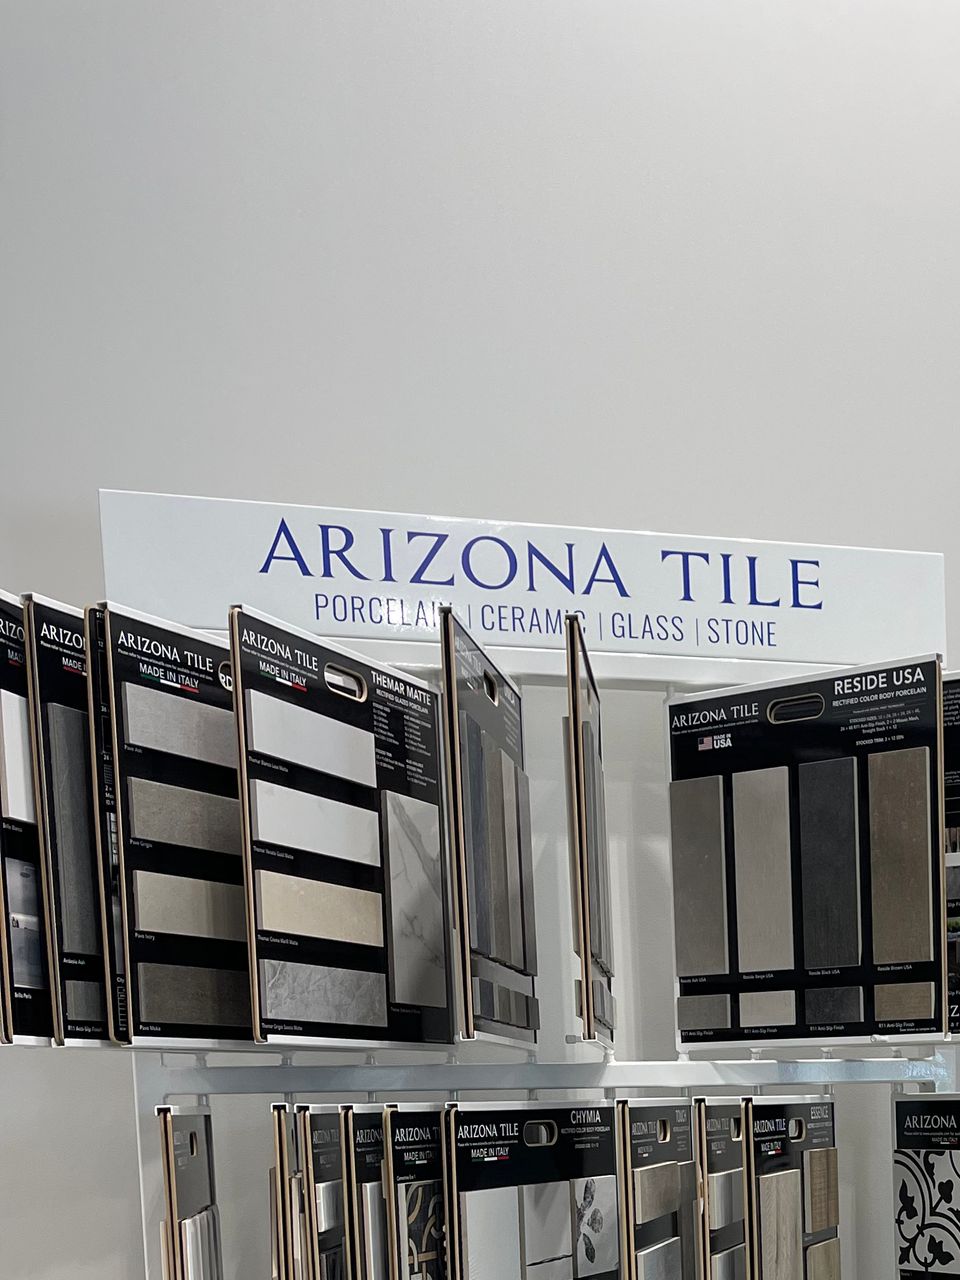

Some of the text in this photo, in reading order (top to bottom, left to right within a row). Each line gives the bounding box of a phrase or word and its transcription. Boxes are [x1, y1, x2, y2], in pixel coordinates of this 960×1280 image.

[259, 517, 825, 610] ARIZONA TILE
[315, 593, 452, 629] PORCELAI
[611, 611, 685, 642] GLASS
[708, 618, 777, 647] STONE
[118, 630, 181, 663] ARIZONA
[183, 651, 214, 673] TILE
[241, 628, 293, 662] ARIZONA
[294, 649, 319, 672] TILE
[139, 662, 199, 689] MADE IN ITALY
[259, 660, 280, 677] MADE
[281, 669, 289, 681] IN
[289, 672, 307, 687] ITALY
[834, 667, 925, 695] RESIDE USA
[370, 670, 432, 706] THEMAR MATTE
[832, 686, 927, 707] RECTIFIED COLOR BODY PORCELAIN
[671, 708, 727, 728] ARIZONA
[730, 702, 759, 718] TILE
[713, 738, 733, 749] USA
[570, 1109, 601, 1124] CHYMIA
[753, 1118, 786, 1134] ARIZONA TILE
[904, 1115, 957, 1129] ARIZONA
[394, 1127, 431, 1142] ARIZONA
[458, 1122, 519, 1139] ARIZONA TILE
[404, 1151, 419, 1161] MADE
[471, 1146, 510, 1158] MADE IN ITALY
